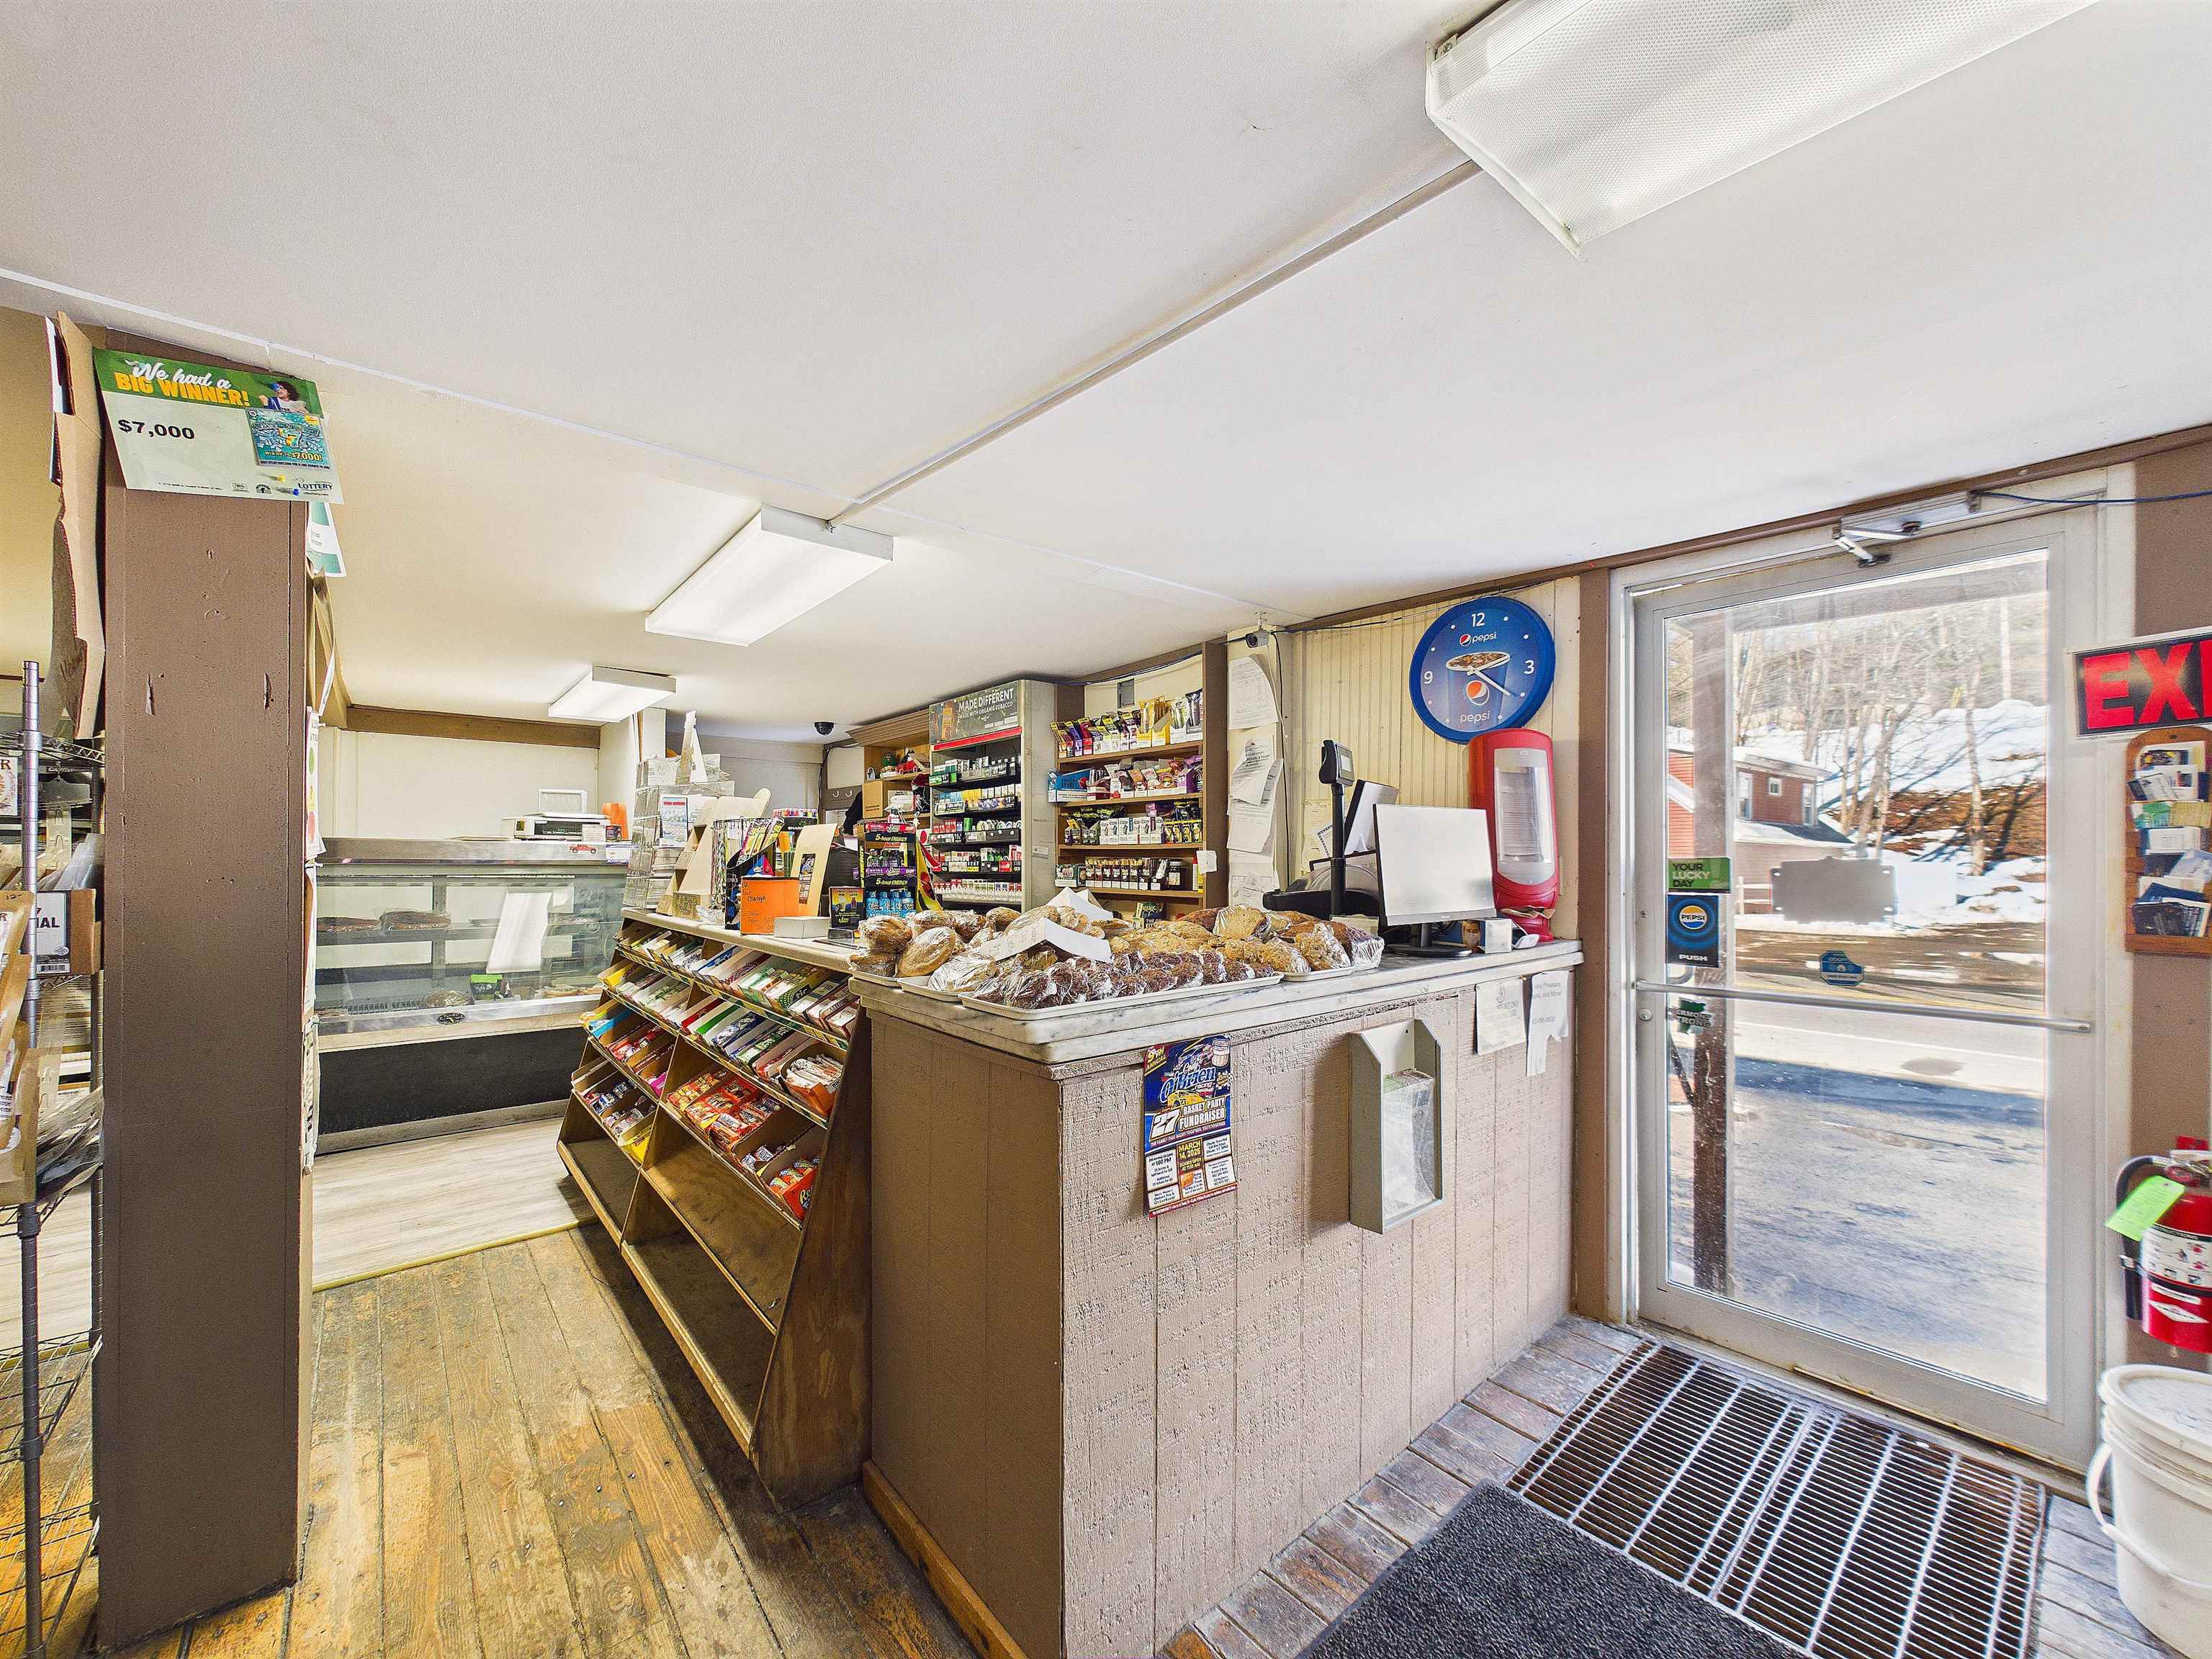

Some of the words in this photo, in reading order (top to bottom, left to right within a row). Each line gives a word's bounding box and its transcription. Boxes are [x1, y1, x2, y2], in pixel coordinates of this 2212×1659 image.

[125, 359, 168, 381] We
[173, 369, 212, 387] had
[217, 379, 231, 389] a
[114, 372, 154, 394] BIG
[158, 379, 250, 407] WINNER!
[118, 418, 195, 440] $7,000
[1471, 613, 1485, 627] 12
[1473, 631, 1497, 644] pepsi
[1524, 660, 1534, 675] 3
[1424, 671, 1433, 685] 9
[959, 699, 977, 712] MADE
[979, 688, 1014, 704] DIFFERENT
[979, 706, 995, 715] ORGANIC
[1460, 711, 1491, 724] pepsi
[1183, 1102, 1205, 1115] BASKET
[1207, 1098, 1225, 1110] PARTY
[1151, 1109, 1180, 1138] 27
[1179, 1109, 1225, 1130] FUNDRAISER
[1178, 1140, 1200, 1152] MARCH
[1187, 1147, 1200, 1157] 2026
